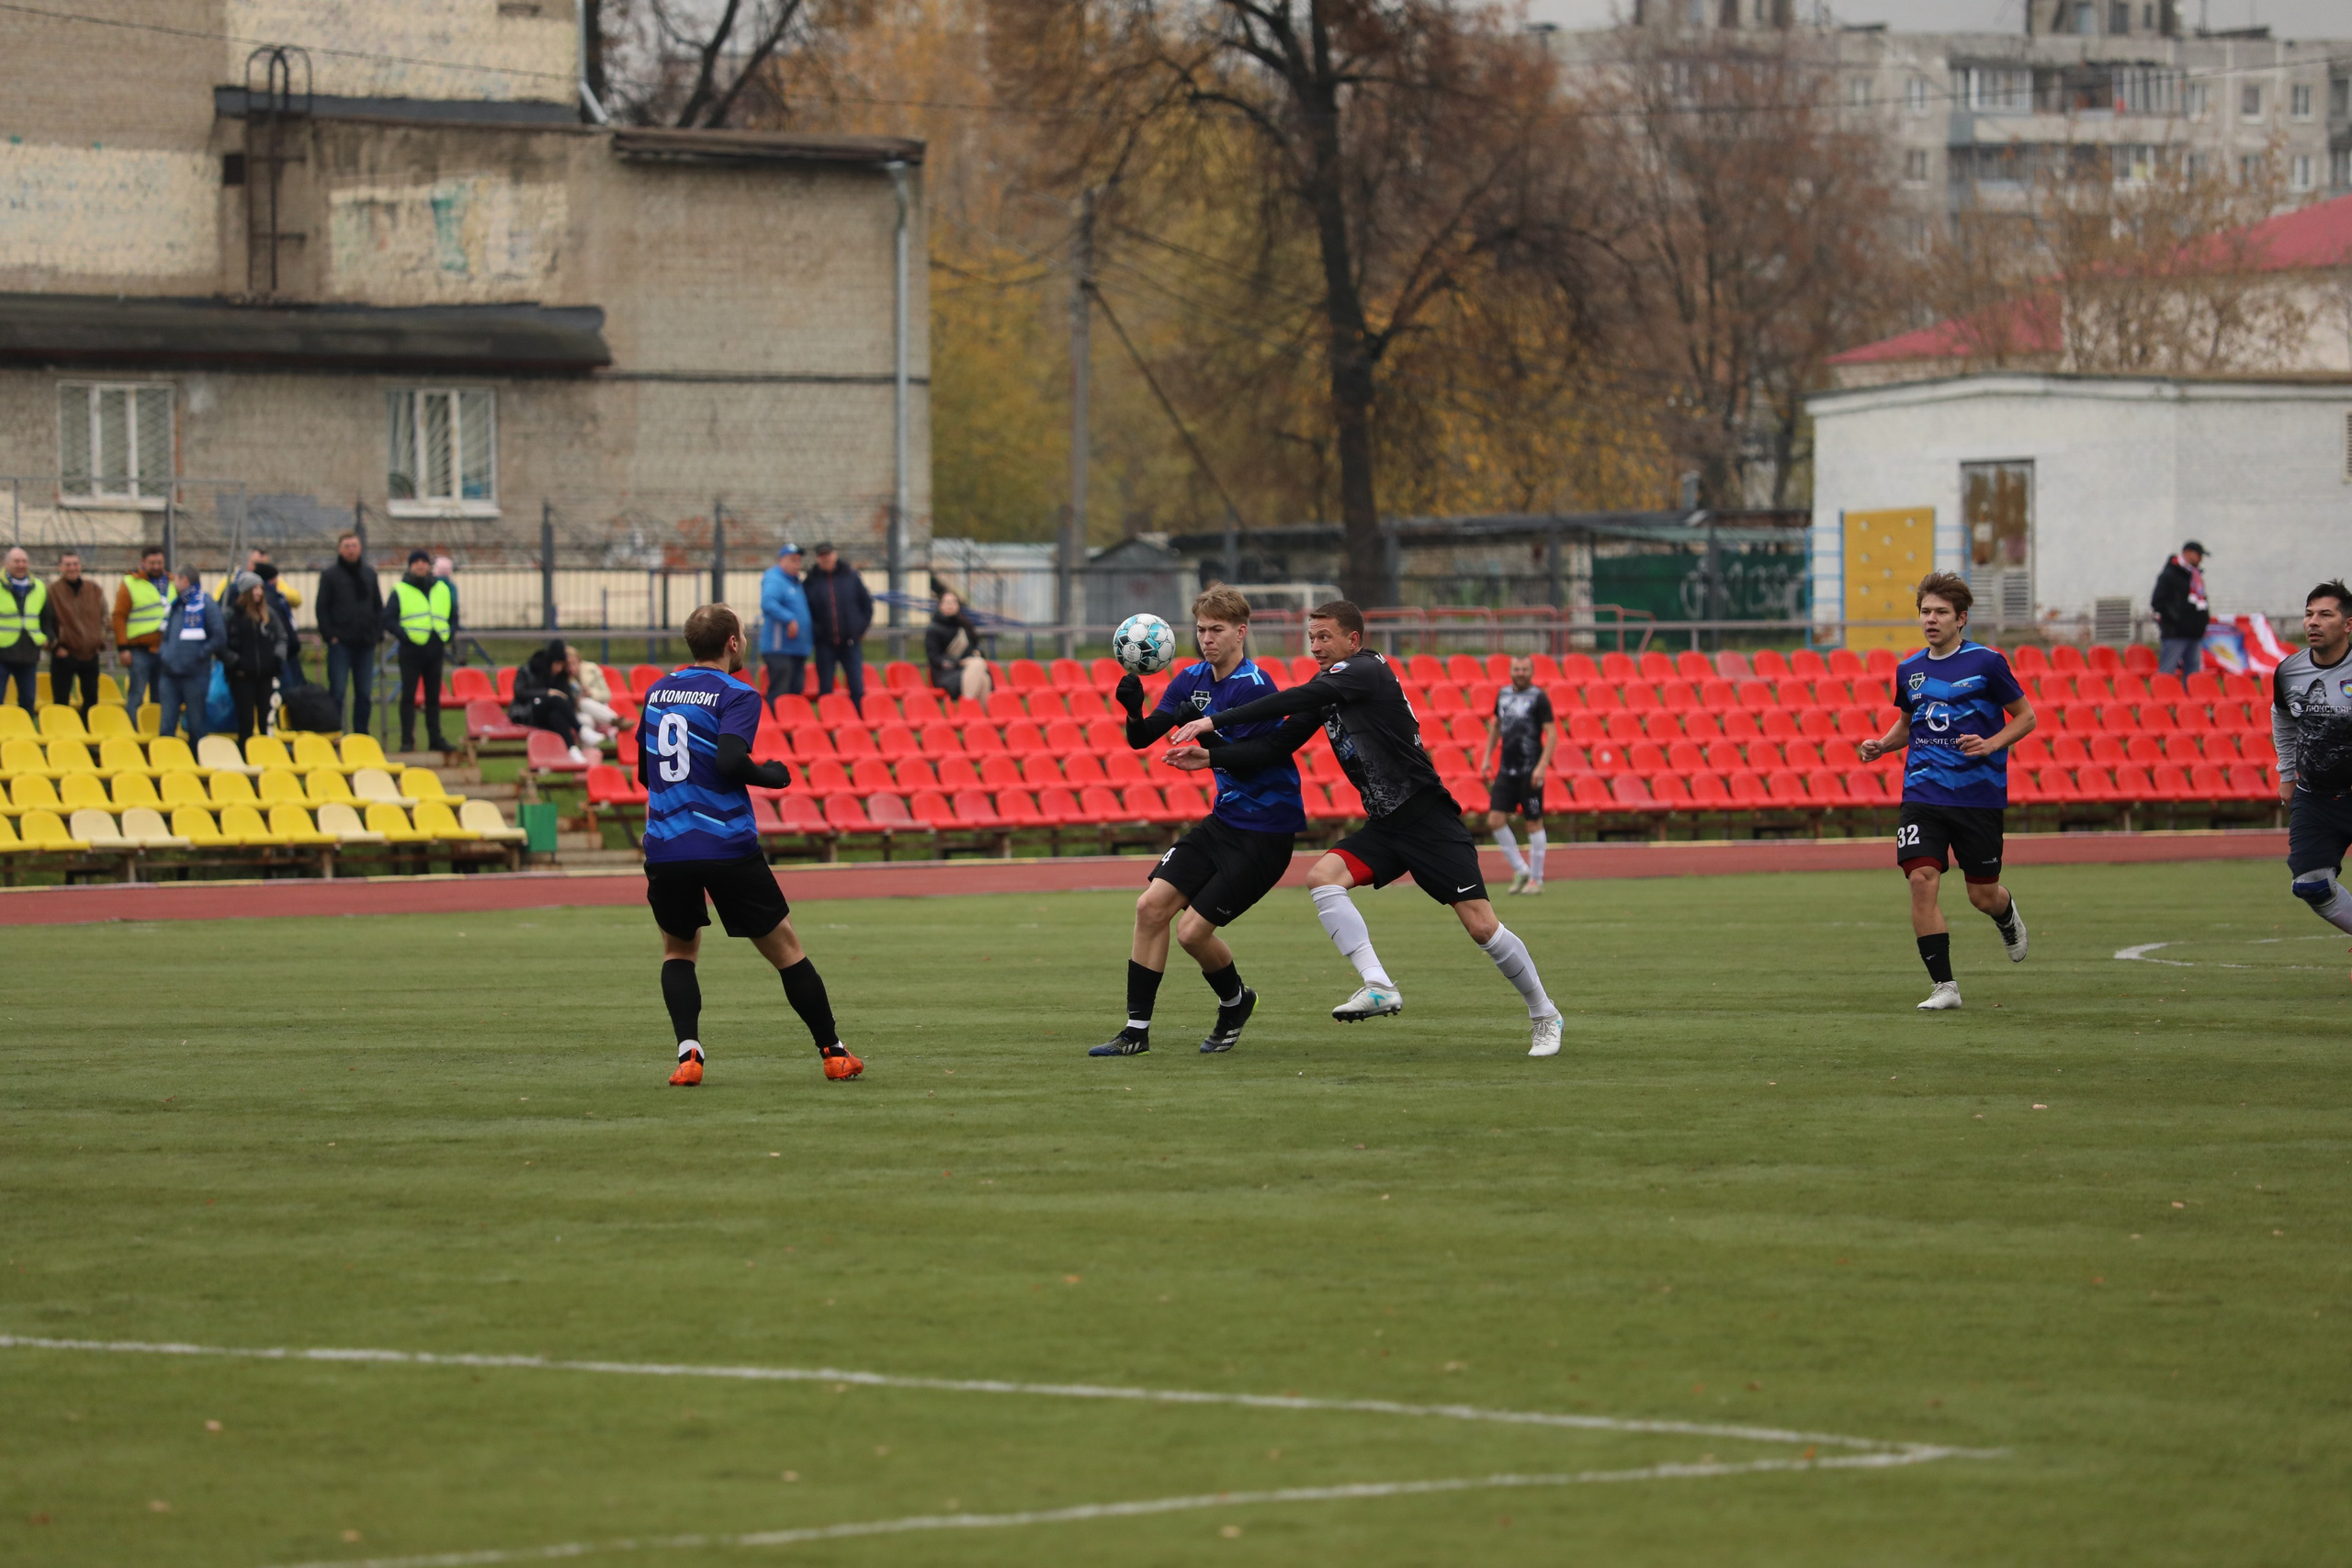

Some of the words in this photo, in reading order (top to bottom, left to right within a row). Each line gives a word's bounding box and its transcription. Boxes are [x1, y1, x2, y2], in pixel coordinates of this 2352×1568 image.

[660, 689, 719, 707] КОМПОЗИТ
[658, 712, 691, 783] 9
[1897, 824, 1920, 849] 32
